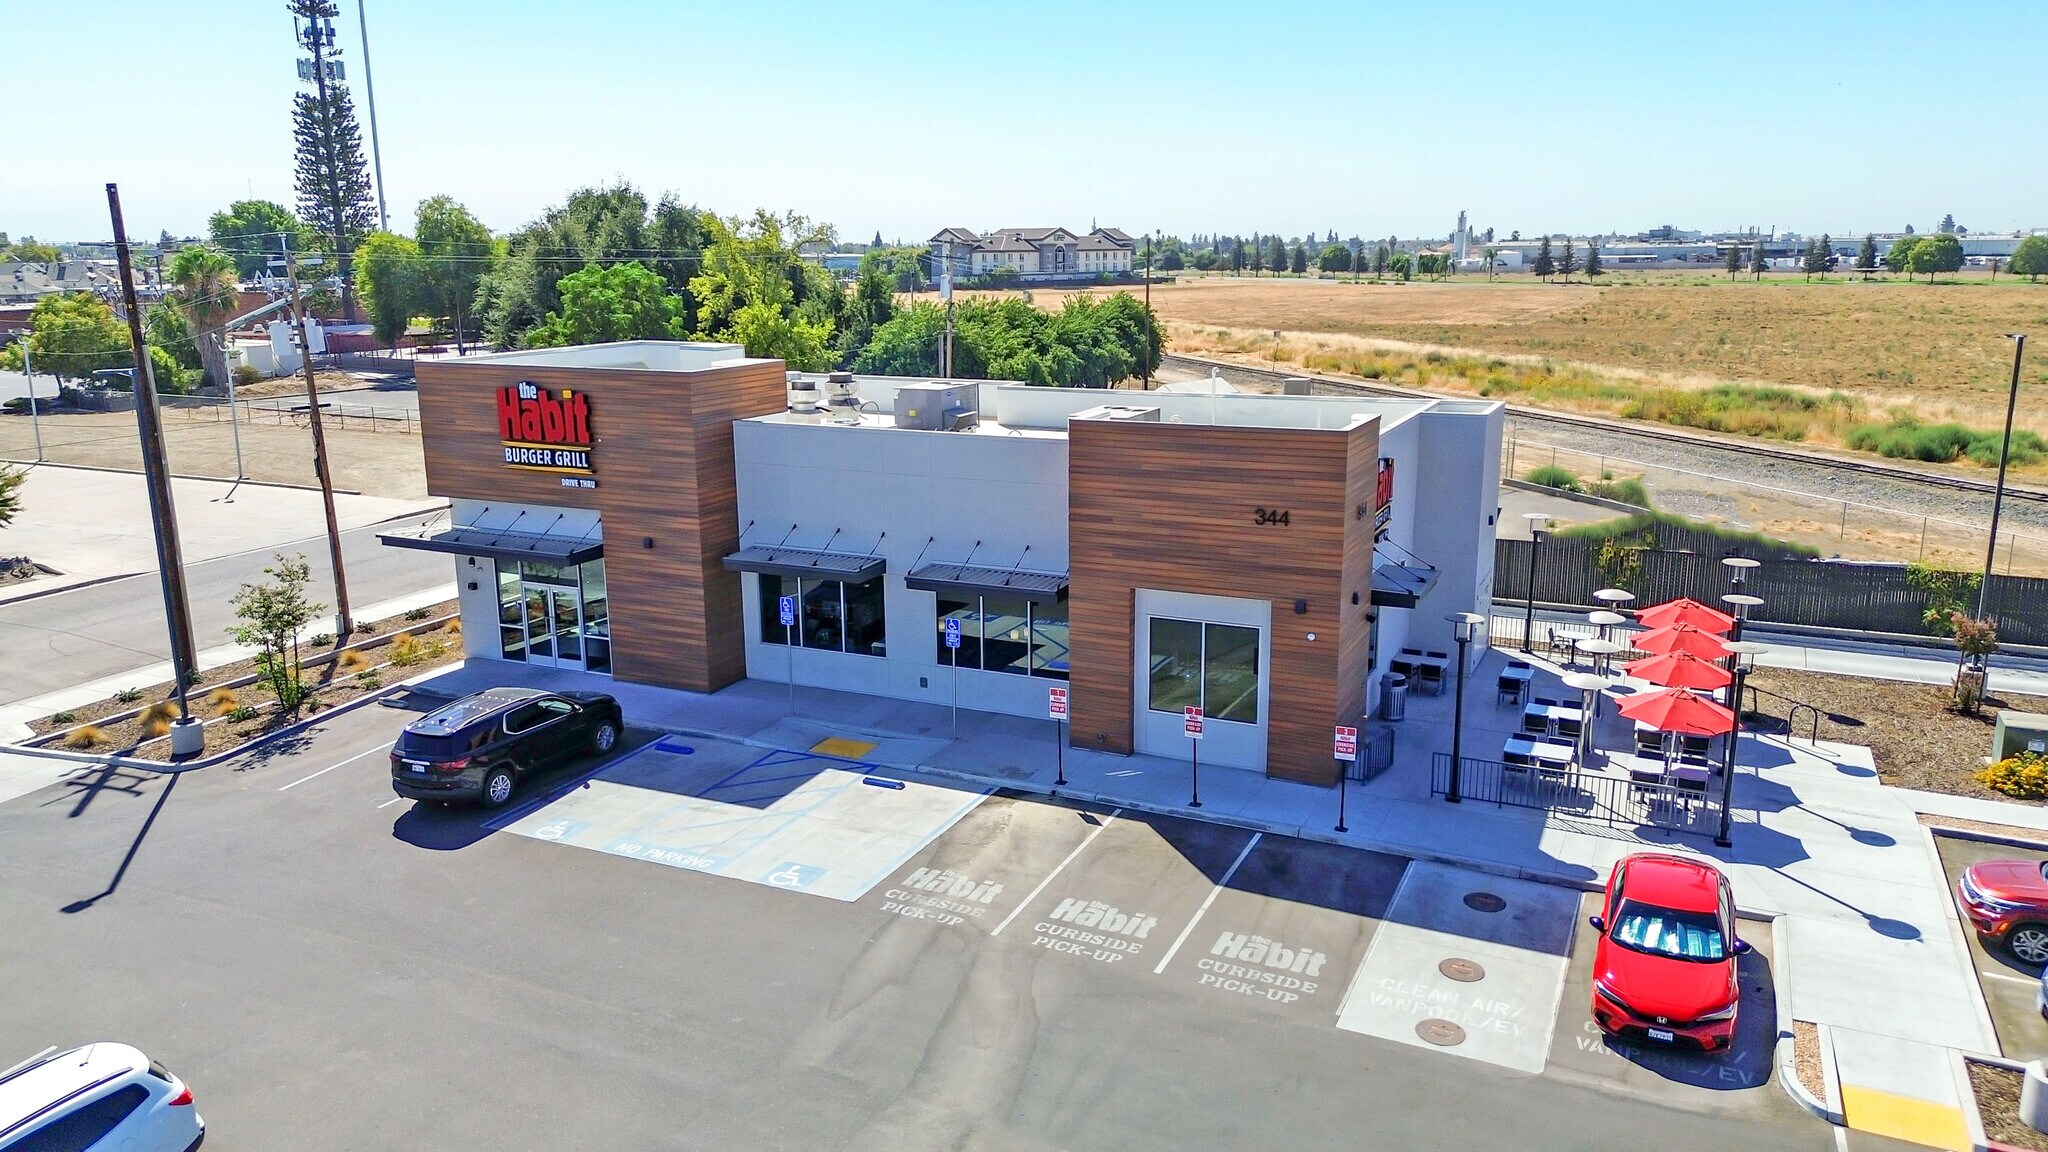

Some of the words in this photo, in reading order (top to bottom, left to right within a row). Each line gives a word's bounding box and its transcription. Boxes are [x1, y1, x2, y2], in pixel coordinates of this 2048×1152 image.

[519, 382, 537, 399] the
[496, 386, 590, 443] Habit
[504, 447, 552, 465] BURGER
[555, 451, 588, 468] GRILL
[561, 478, 579, 487] DRIVE
[580, 479, 596, 489] THRU
[1254, 508, 1290, 527] 344
[614, 842, 643, 853] NO
[642, 848, 715, 868] PARKING
[901, 867, 1005, 904] Habit
[880, 901, 965, 926] PICK-UP
[1049, 898, 1158, 939] Habit
[1089, 900, 1110, 910] the
[1031, 935, 1123, 963] PICK-UP
[1034, 922, 1144, 954] CURBSIDE
[1251, 935, 1272, 946] the
[1210, 931, 1327, 977] Habit
[1197, 958, 1318, 994] CURBSIDE
[1198, 973, 1299, 1004] PICK-UP
[1380, 978, 1460, 1003] CLEAN
[1471, 998, 1527, 1018] AIR/
[1370, 991, 1527, 1037] VANPOOL/EV
